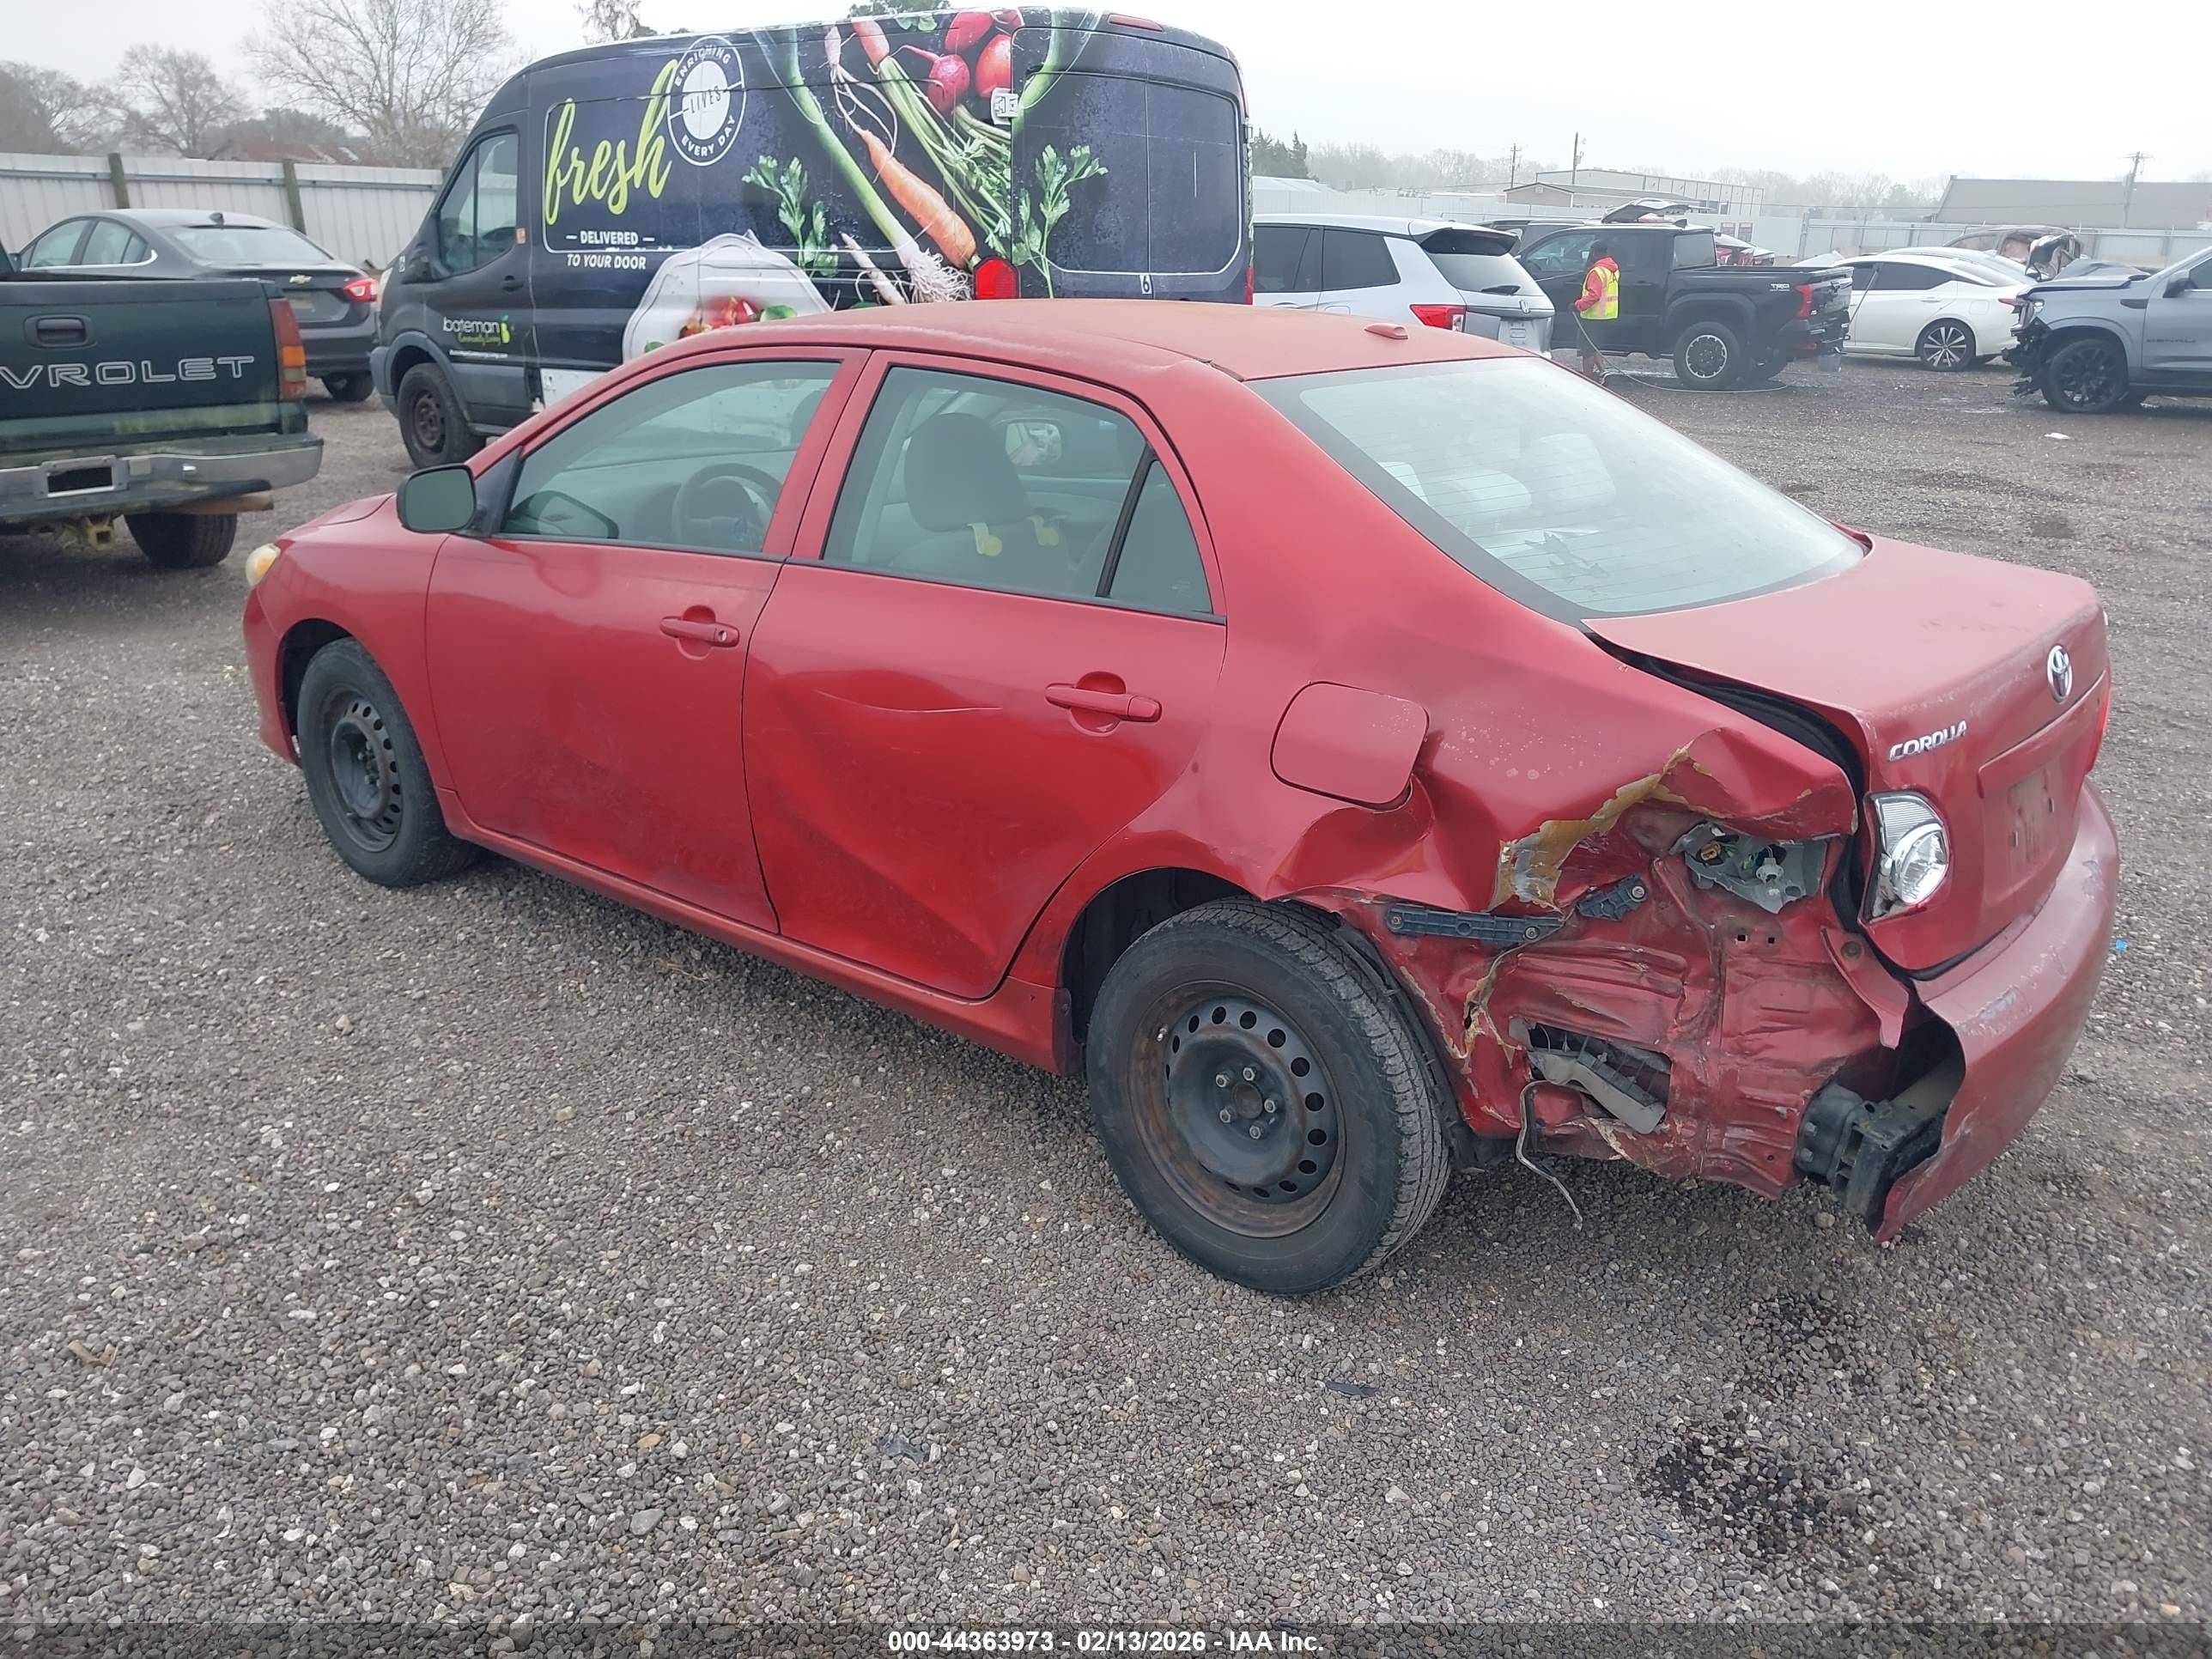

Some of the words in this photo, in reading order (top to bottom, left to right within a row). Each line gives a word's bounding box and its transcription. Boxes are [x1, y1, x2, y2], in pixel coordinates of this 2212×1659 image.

[674, 45, 731, 87] ENRICHING
[690, 85, 722, 114] LIVES
[546, 58, 677, 226] fresh
[681, 134, 714, 157] EVERY
[717, 114, 736, 146] DAY
[580, 230, 639, 246] DELIVERED
[567, 253, 581, 267] TO
[583, 254, 612, 269] YOUR
[613, 255, 647, 270] DOOR
[1142, 275, 1150, 293] 6
[442, 316, 501, 334] bateman
[1888, 720, 1967, 762] COROLLA
